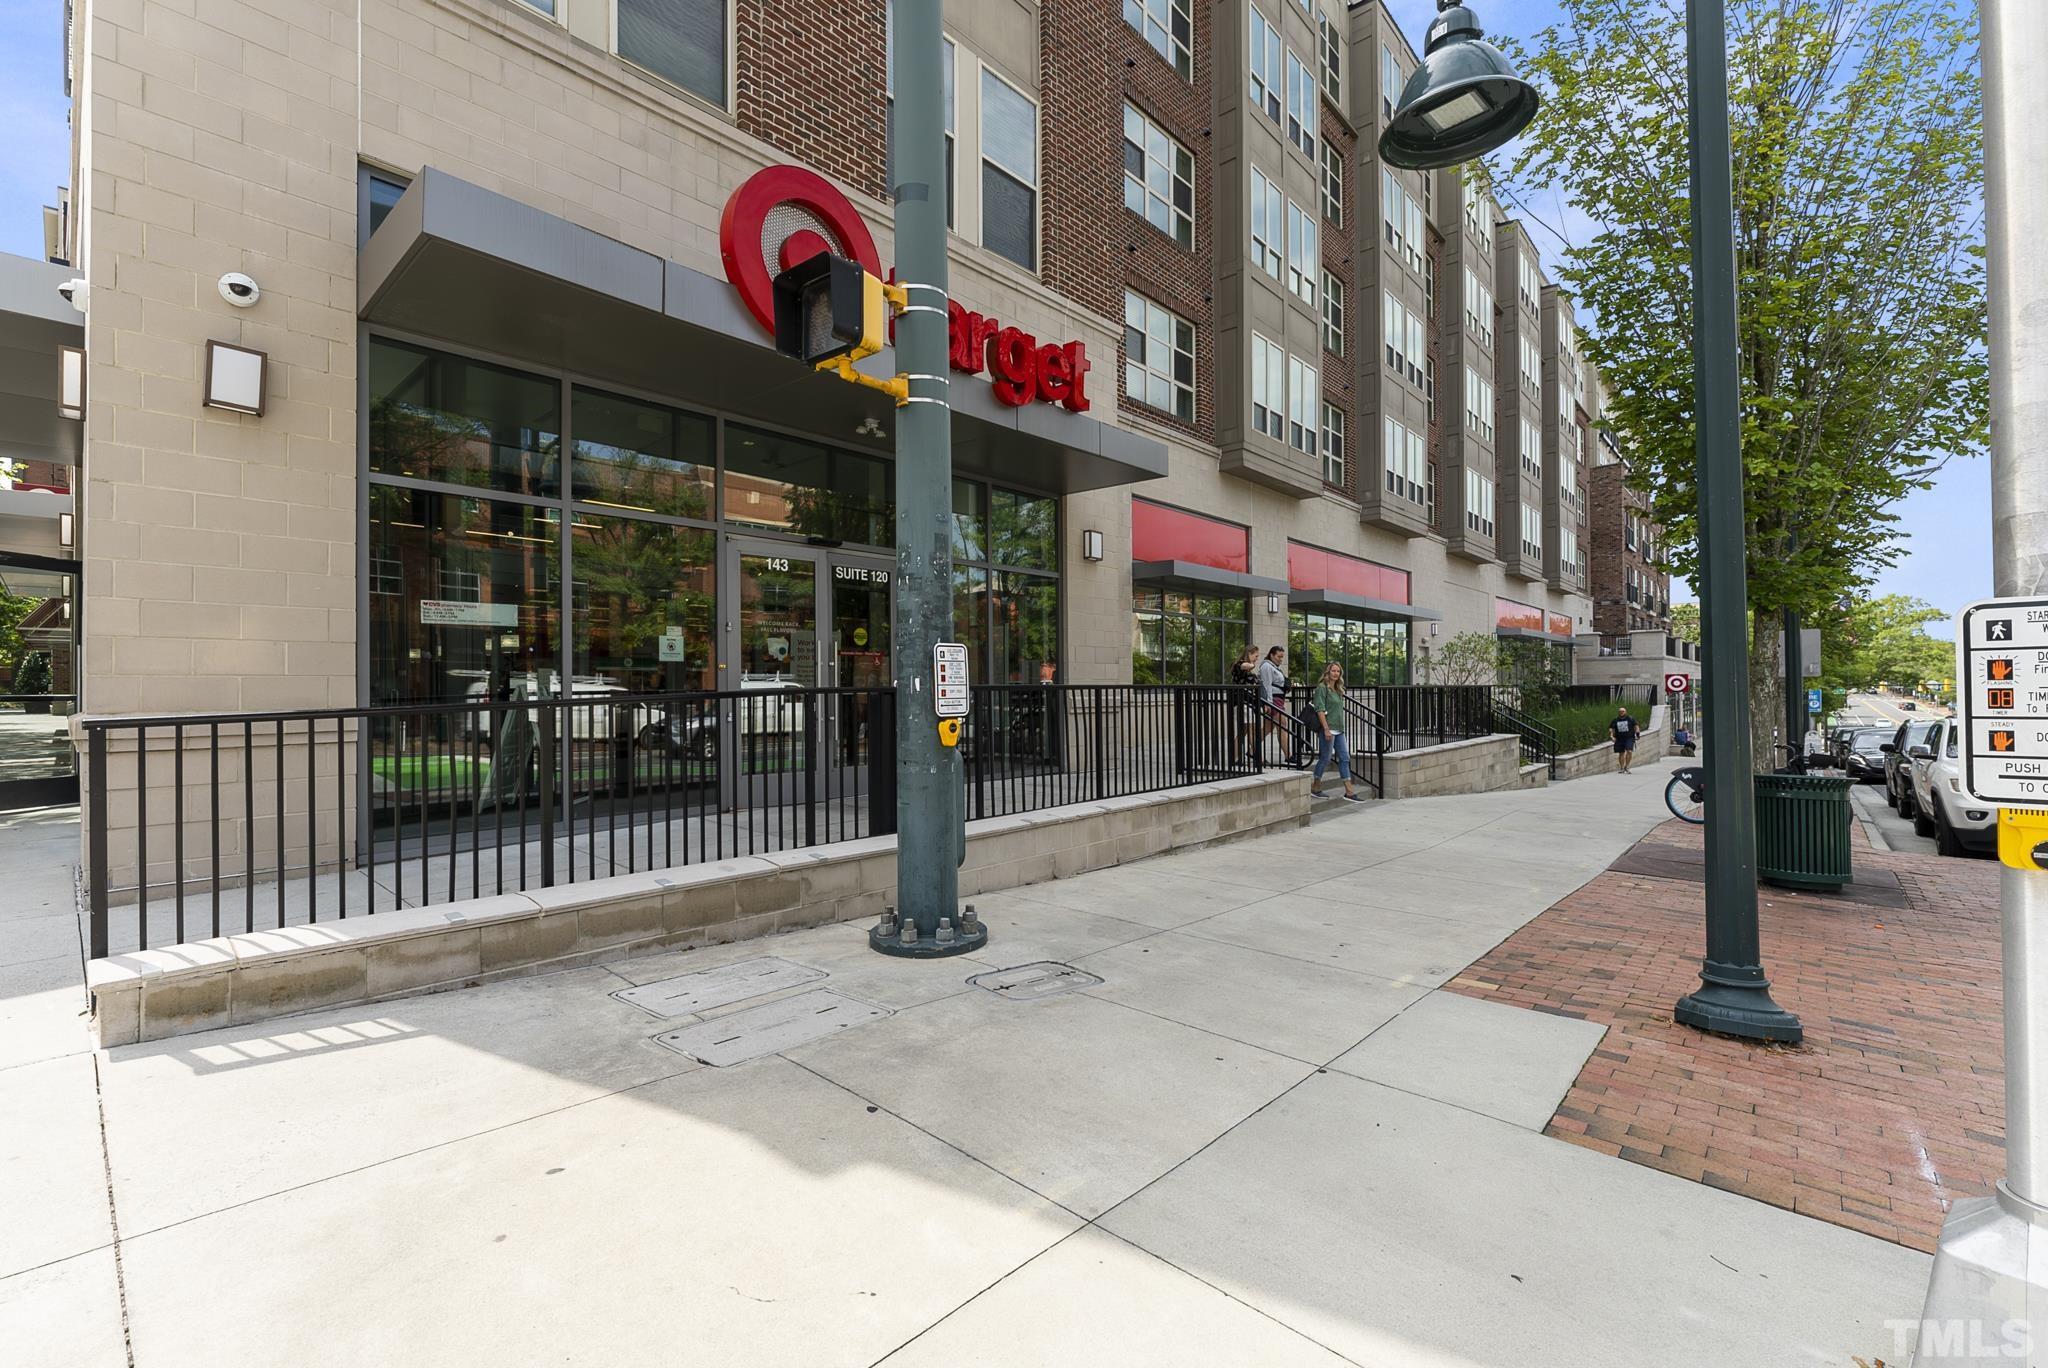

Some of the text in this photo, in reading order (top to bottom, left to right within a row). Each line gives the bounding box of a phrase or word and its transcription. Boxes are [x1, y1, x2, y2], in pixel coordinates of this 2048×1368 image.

[766, 558, 788, 571] 143
[836, 567, 888, 583] SUITE 120
[2026, 704, 2037, 713] To
[2005, 763, 2041, 773] PUSH
[2019, 783, 2034, 792] TO
